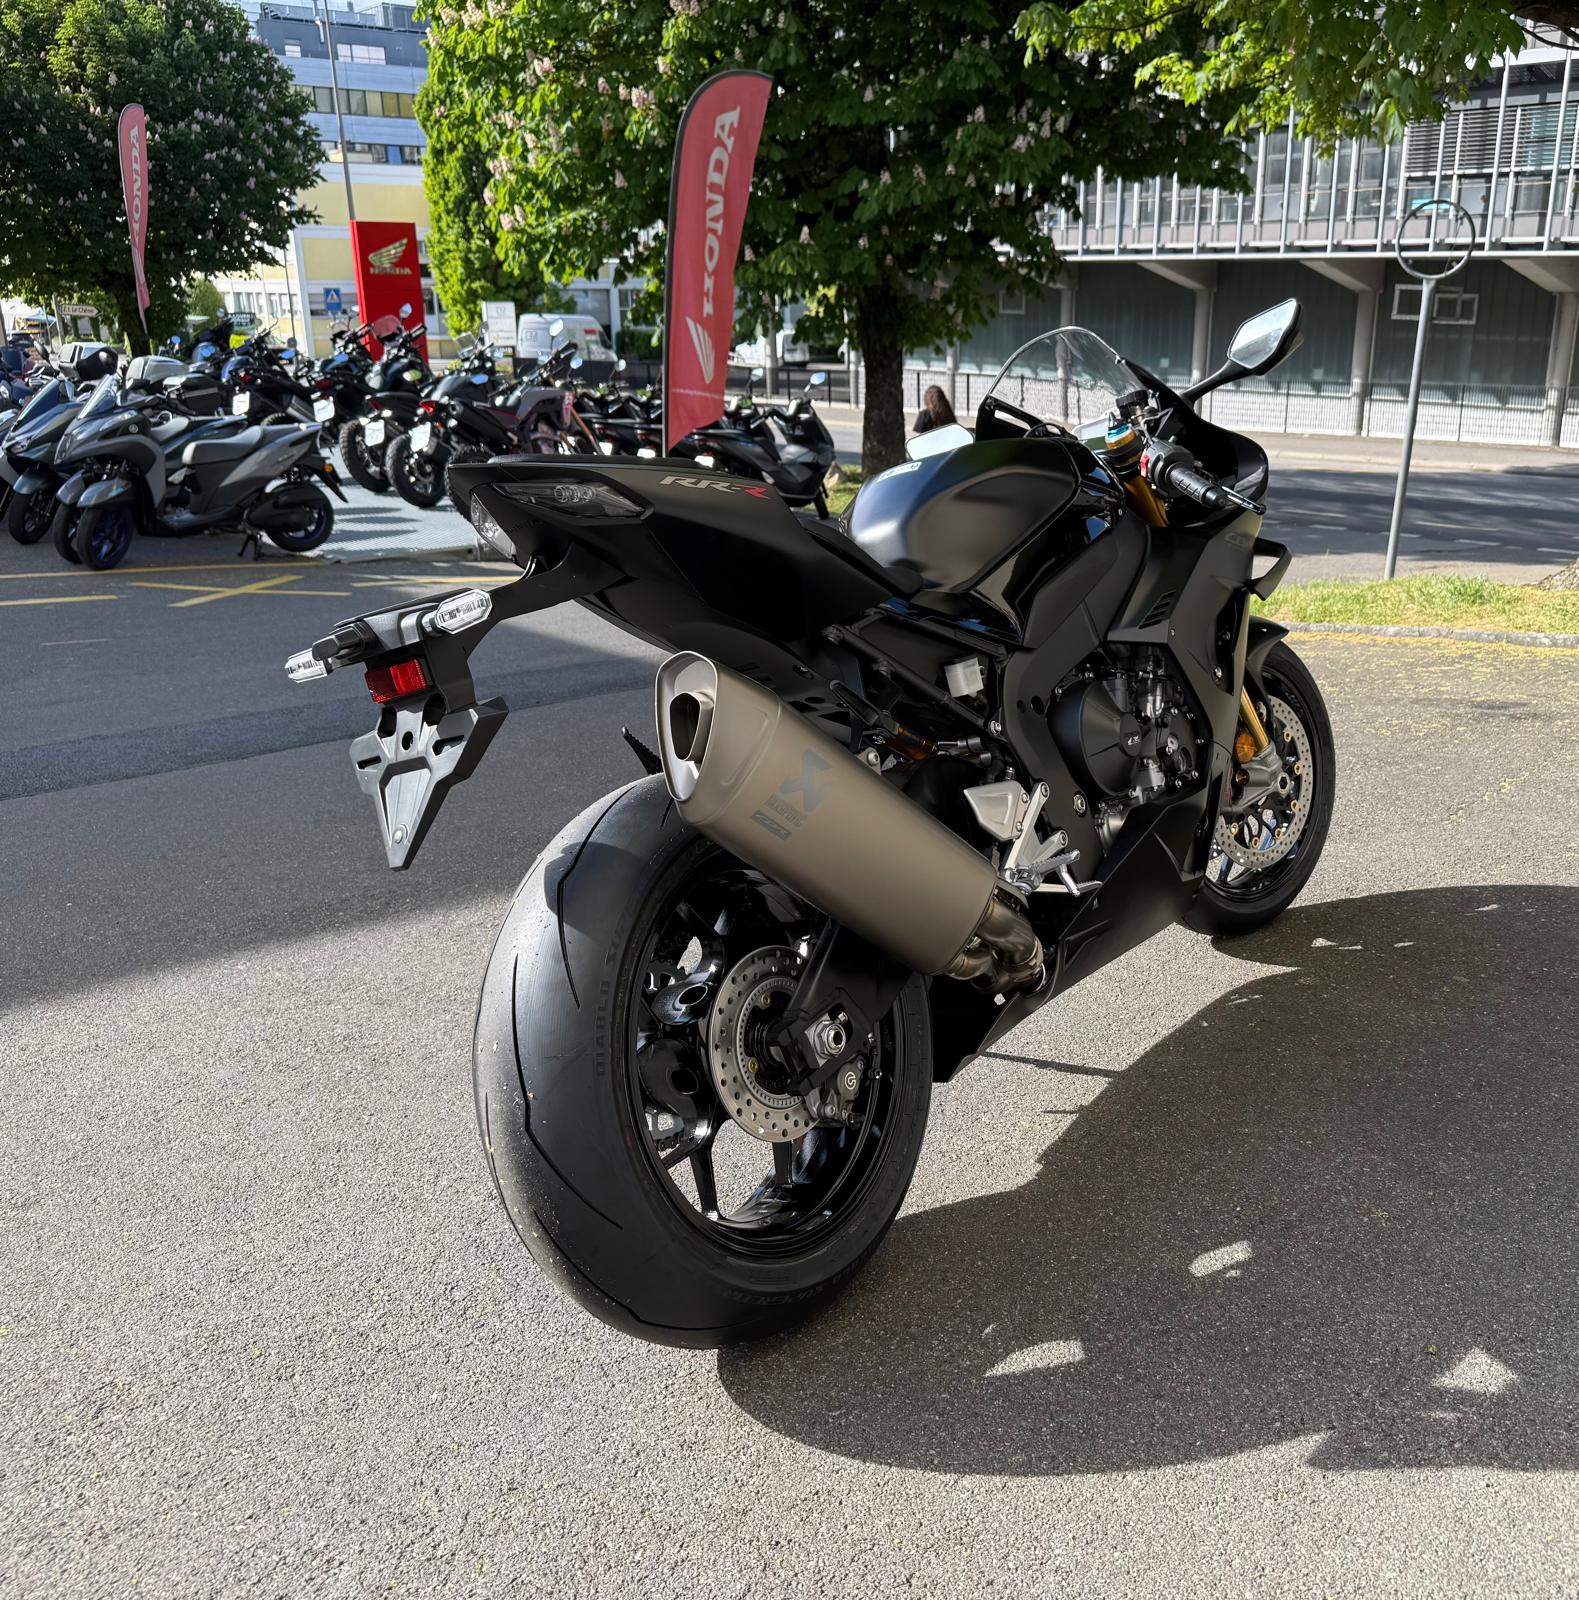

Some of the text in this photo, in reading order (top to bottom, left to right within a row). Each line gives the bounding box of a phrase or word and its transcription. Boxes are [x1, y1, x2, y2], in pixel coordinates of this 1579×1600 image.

[131, 125, 142, 244] HONDA
[703, 105, 741, 317] HONDA
[369, 267, 413, 275] HONDA
[596, 979, 611, 1078] DIABLO
